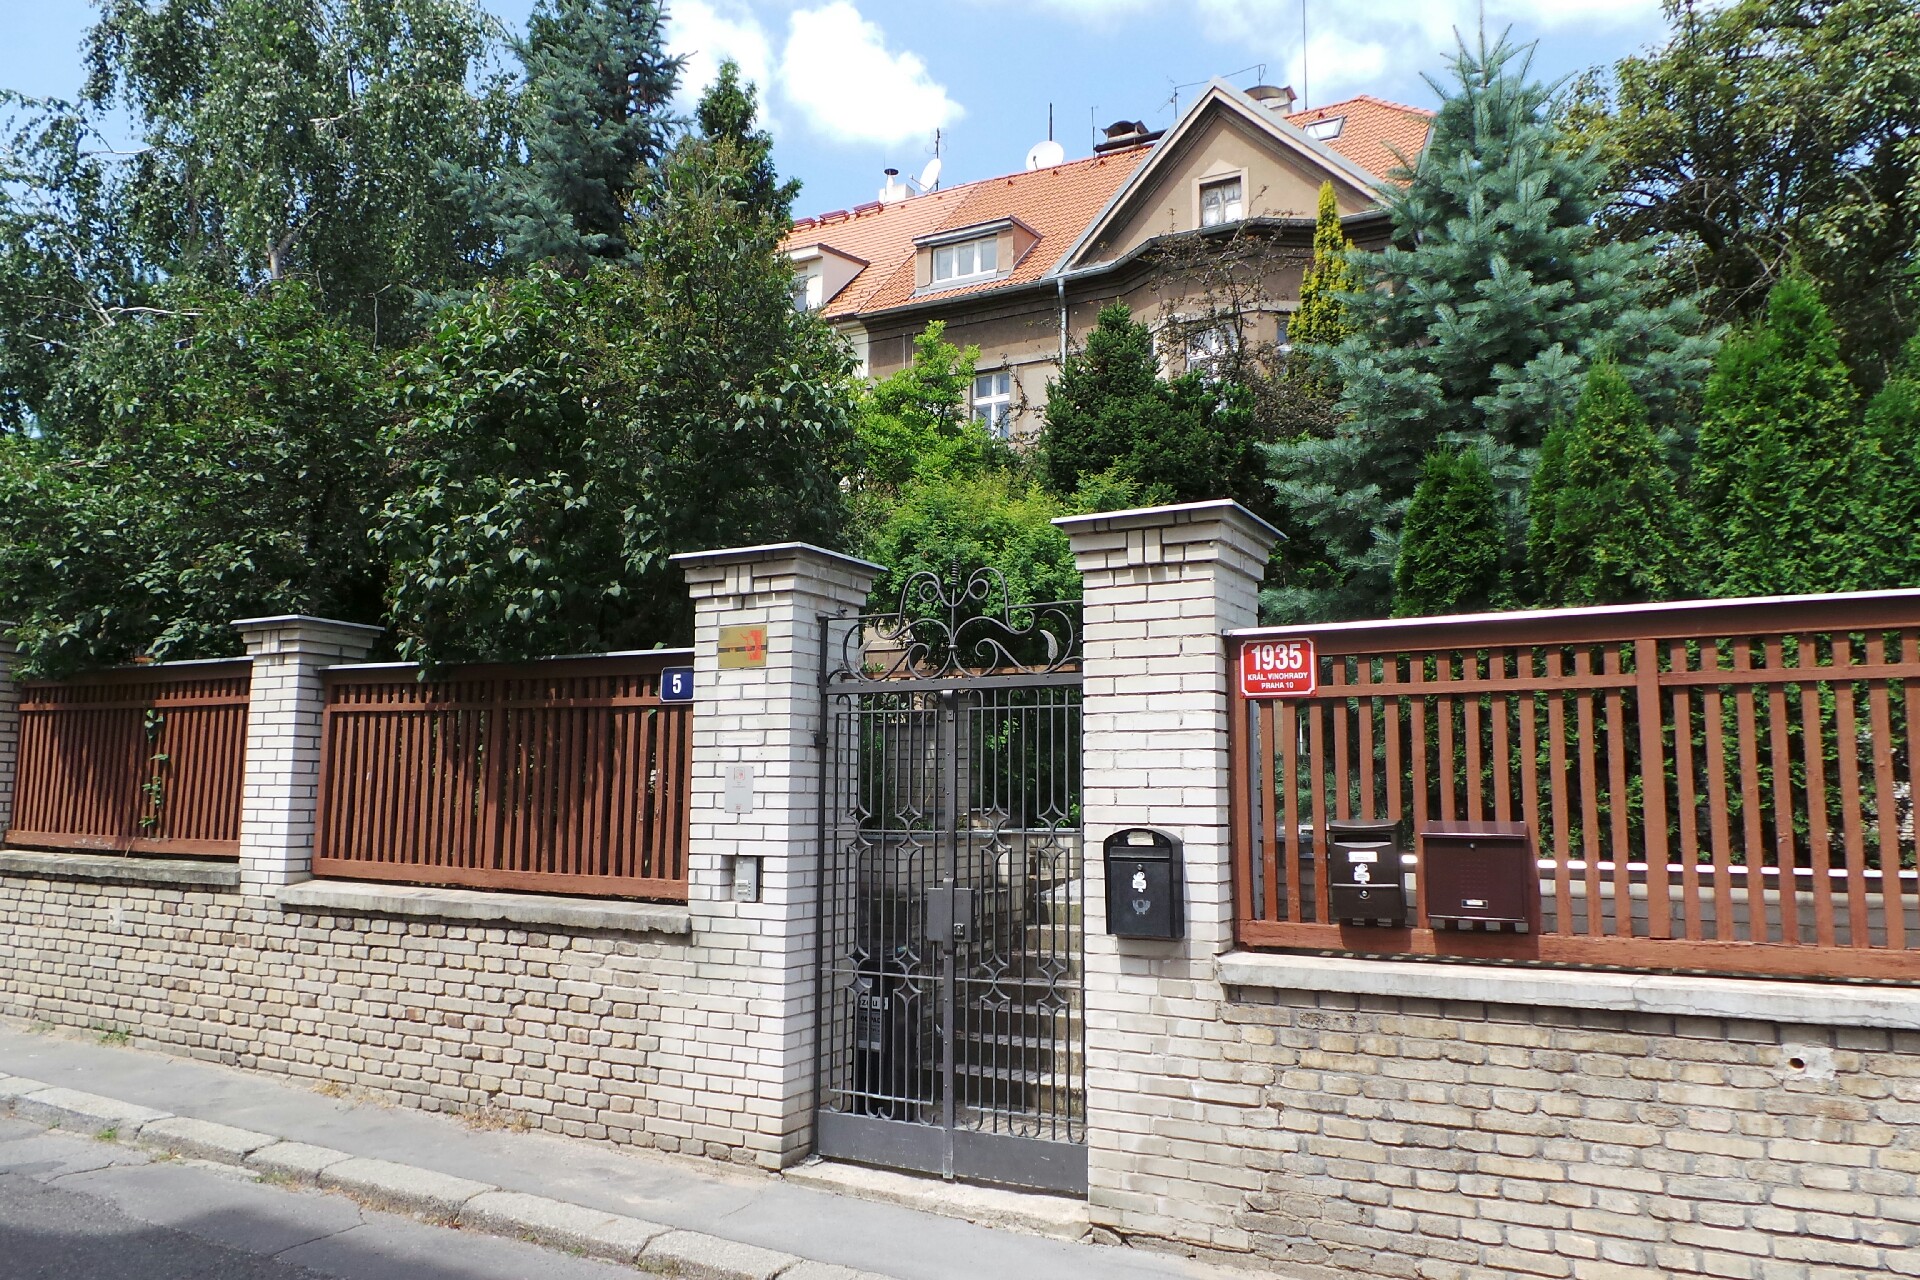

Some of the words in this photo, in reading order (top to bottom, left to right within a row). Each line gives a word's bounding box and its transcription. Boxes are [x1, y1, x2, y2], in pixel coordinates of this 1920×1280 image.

[1251, 644, 1303, 670] 1935
[1248, 672, 1267, 680] KRÁL.
[1268, 671, 1308, 680] VINOHRADY
[672, 673, 682, 694] 5
[1285, 681, 1294, 689] 10
